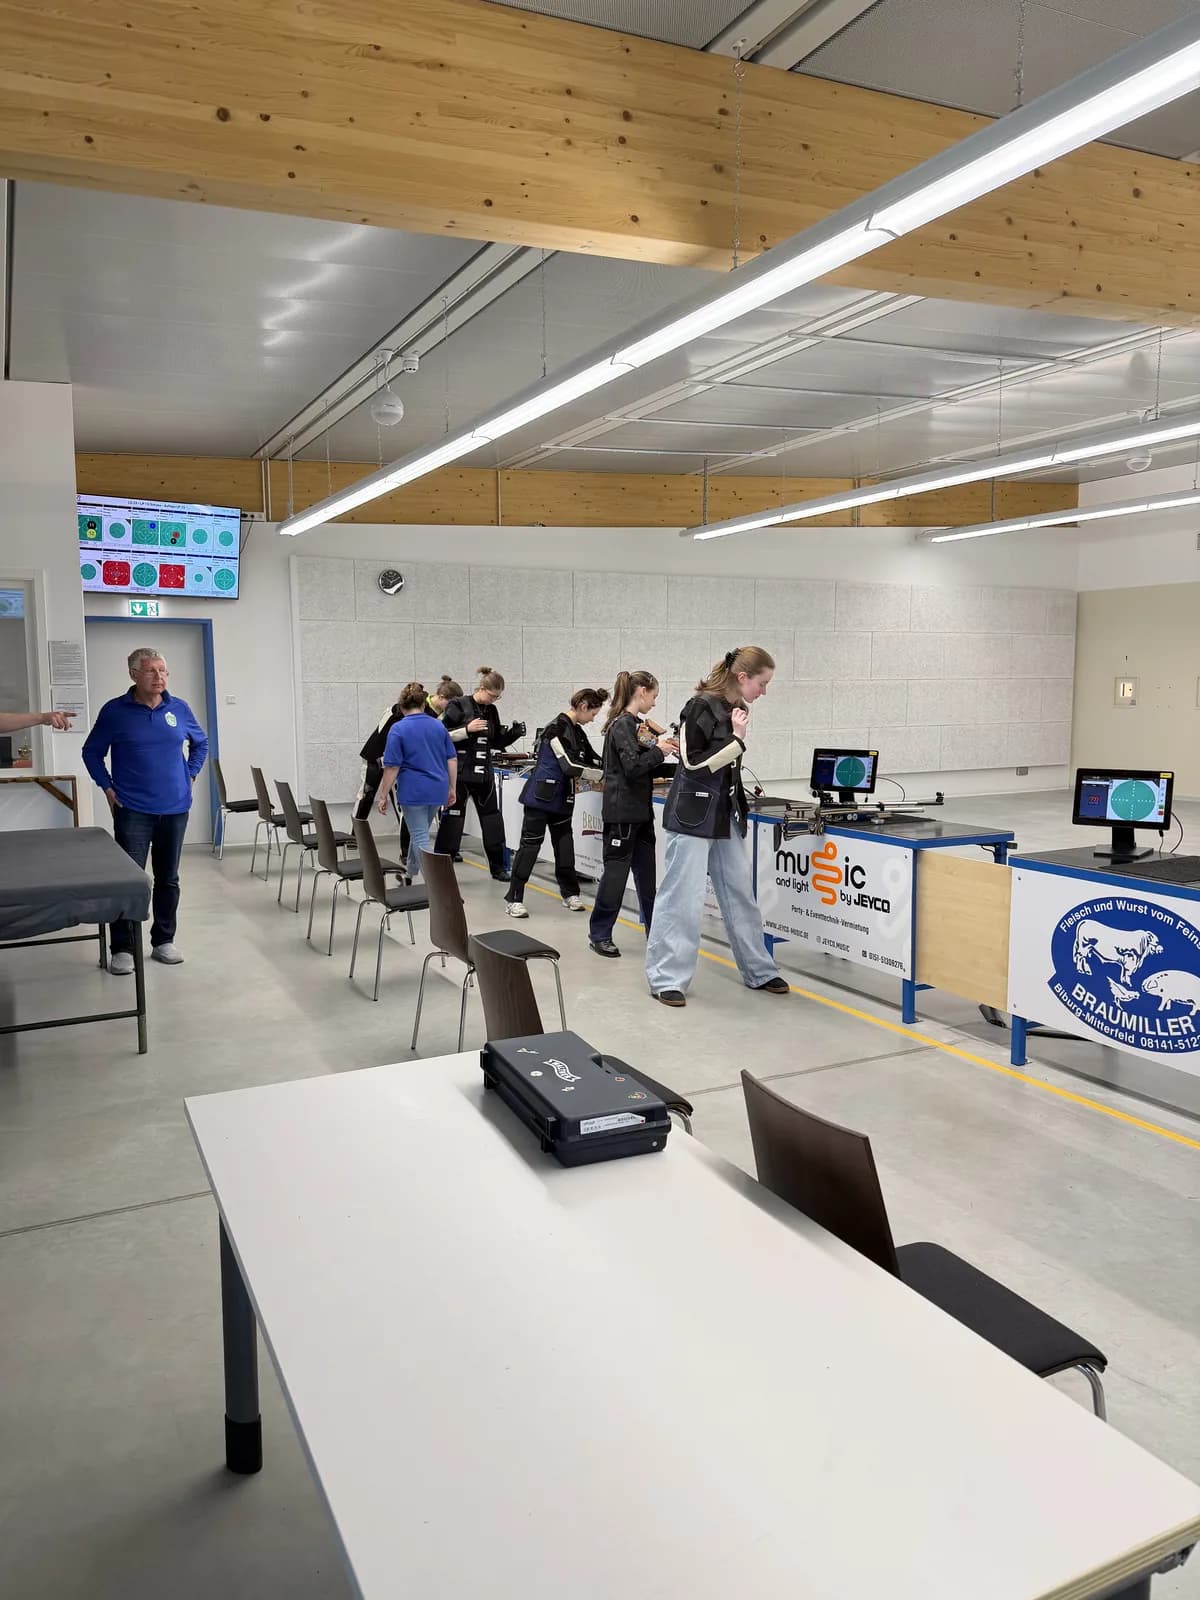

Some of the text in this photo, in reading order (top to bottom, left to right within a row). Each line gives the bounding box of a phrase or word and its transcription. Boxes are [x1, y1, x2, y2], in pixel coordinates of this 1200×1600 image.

[776, 877, 809, 893] and light
[840, 890, 891, 914] by JEYCO
[1060, 905, 1092, 933] Fleisch
[1093, 900, 1113, 912] und
[1116, 900, 1148, 915] Wurst
[1151, 908, 1174, 926] vom
[1054, 983, 1135, 1044] Biburg-Mitterfeld
[1072, 983, 1196, 1036] BRAUMILLER
